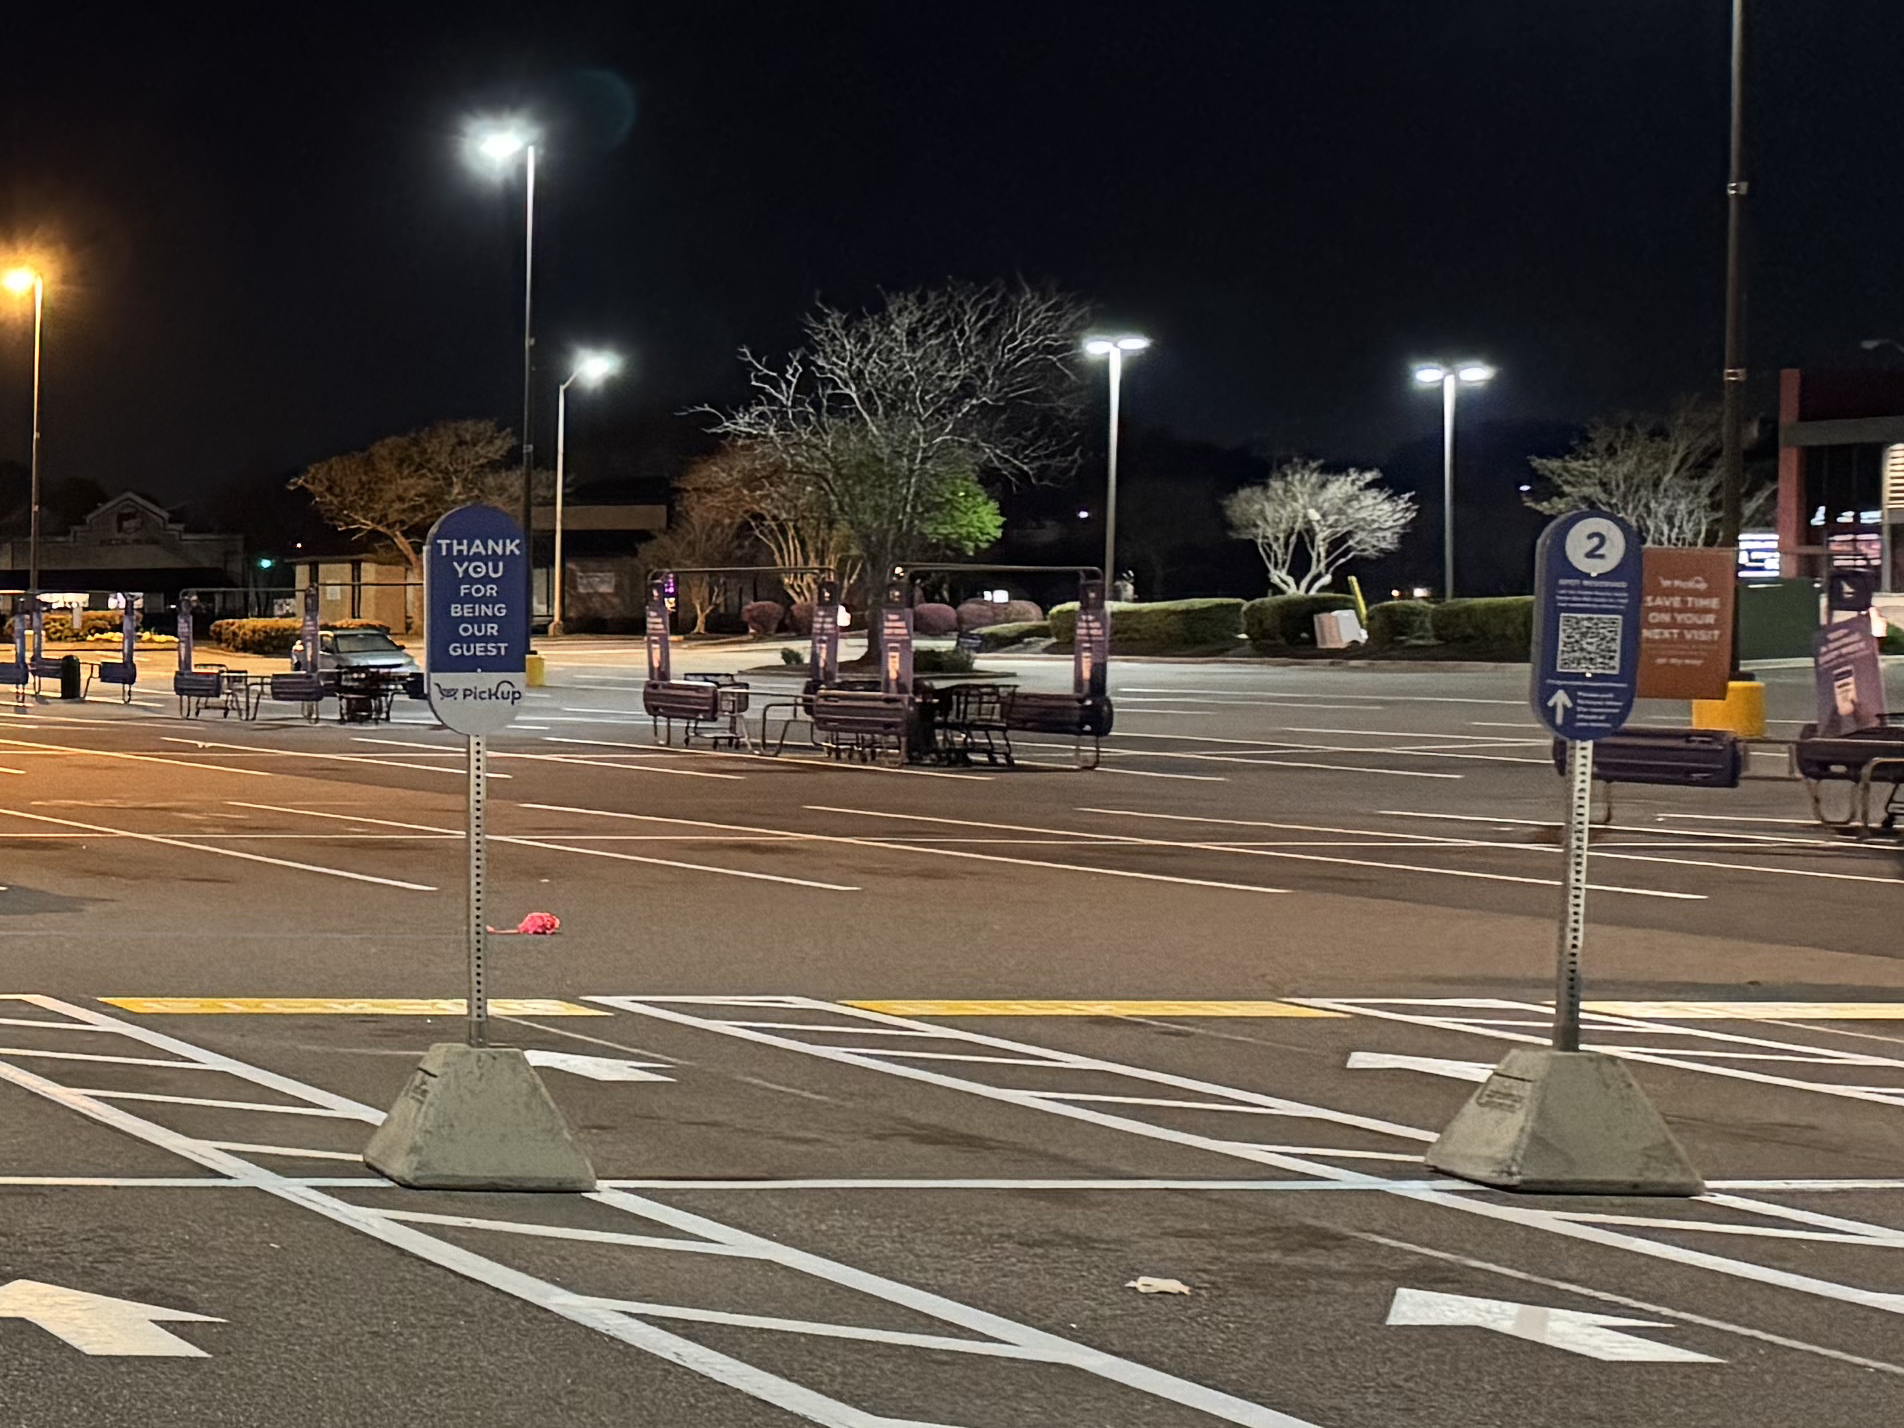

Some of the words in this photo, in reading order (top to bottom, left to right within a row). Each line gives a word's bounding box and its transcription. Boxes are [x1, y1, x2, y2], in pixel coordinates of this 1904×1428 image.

[436, 538, 521, 556] THANK
[1584, 531, 1606, 560] 2
[453, 561, 504, 578] YOU
[460, 584, 498, 597] FOR
[450, 603, 507, 617] BEING
[458, 623, 498, 637] OUR
[448, 643, 509, 656] GUEST
